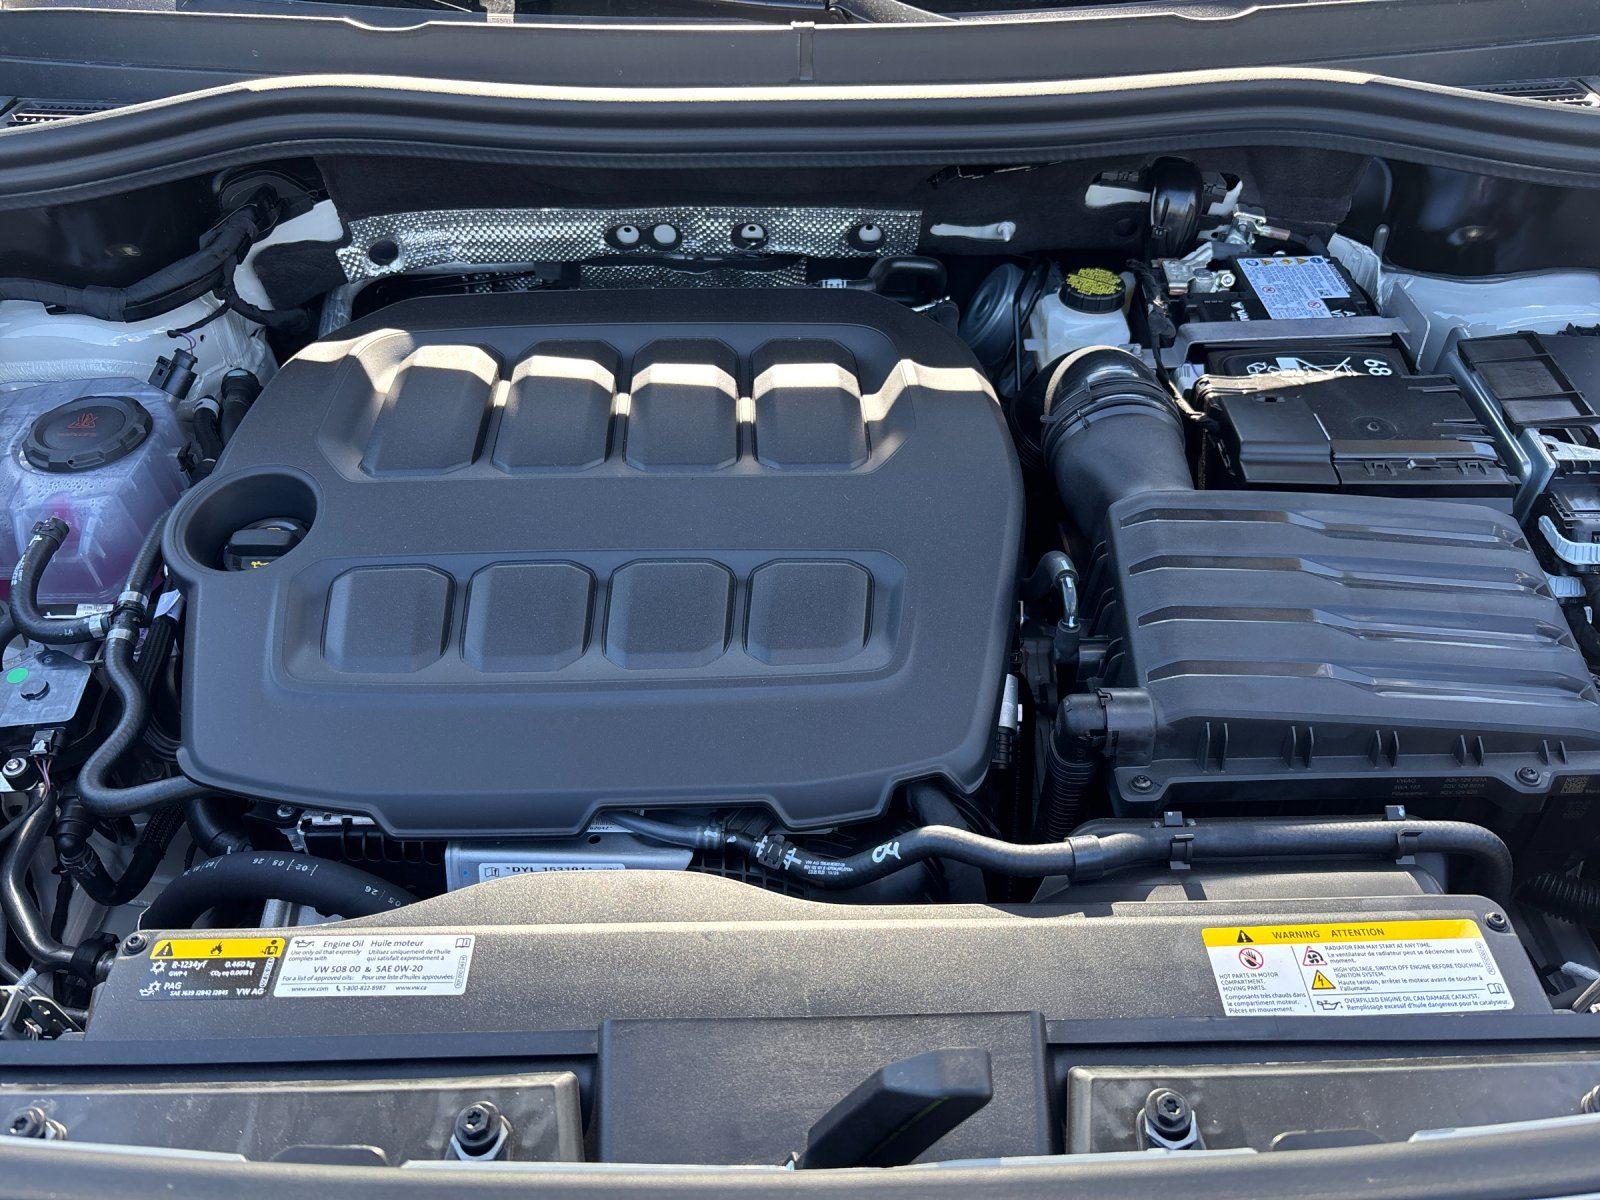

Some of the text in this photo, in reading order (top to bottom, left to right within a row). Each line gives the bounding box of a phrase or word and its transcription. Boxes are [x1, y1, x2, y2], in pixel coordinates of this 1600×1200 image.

[1272, 928, 1385, 939] WARNING ATTENTION
[323, 941, 351, 949] Engine
[313, 965, 330, 973] VW
[330, 965, 347, 973] 508
[348, 965, 361, 973] 00
[375, 965, 392, 973] SAE
[163, 982, 183, 990] PAG
[236, 988, 265, 996] VW AG
